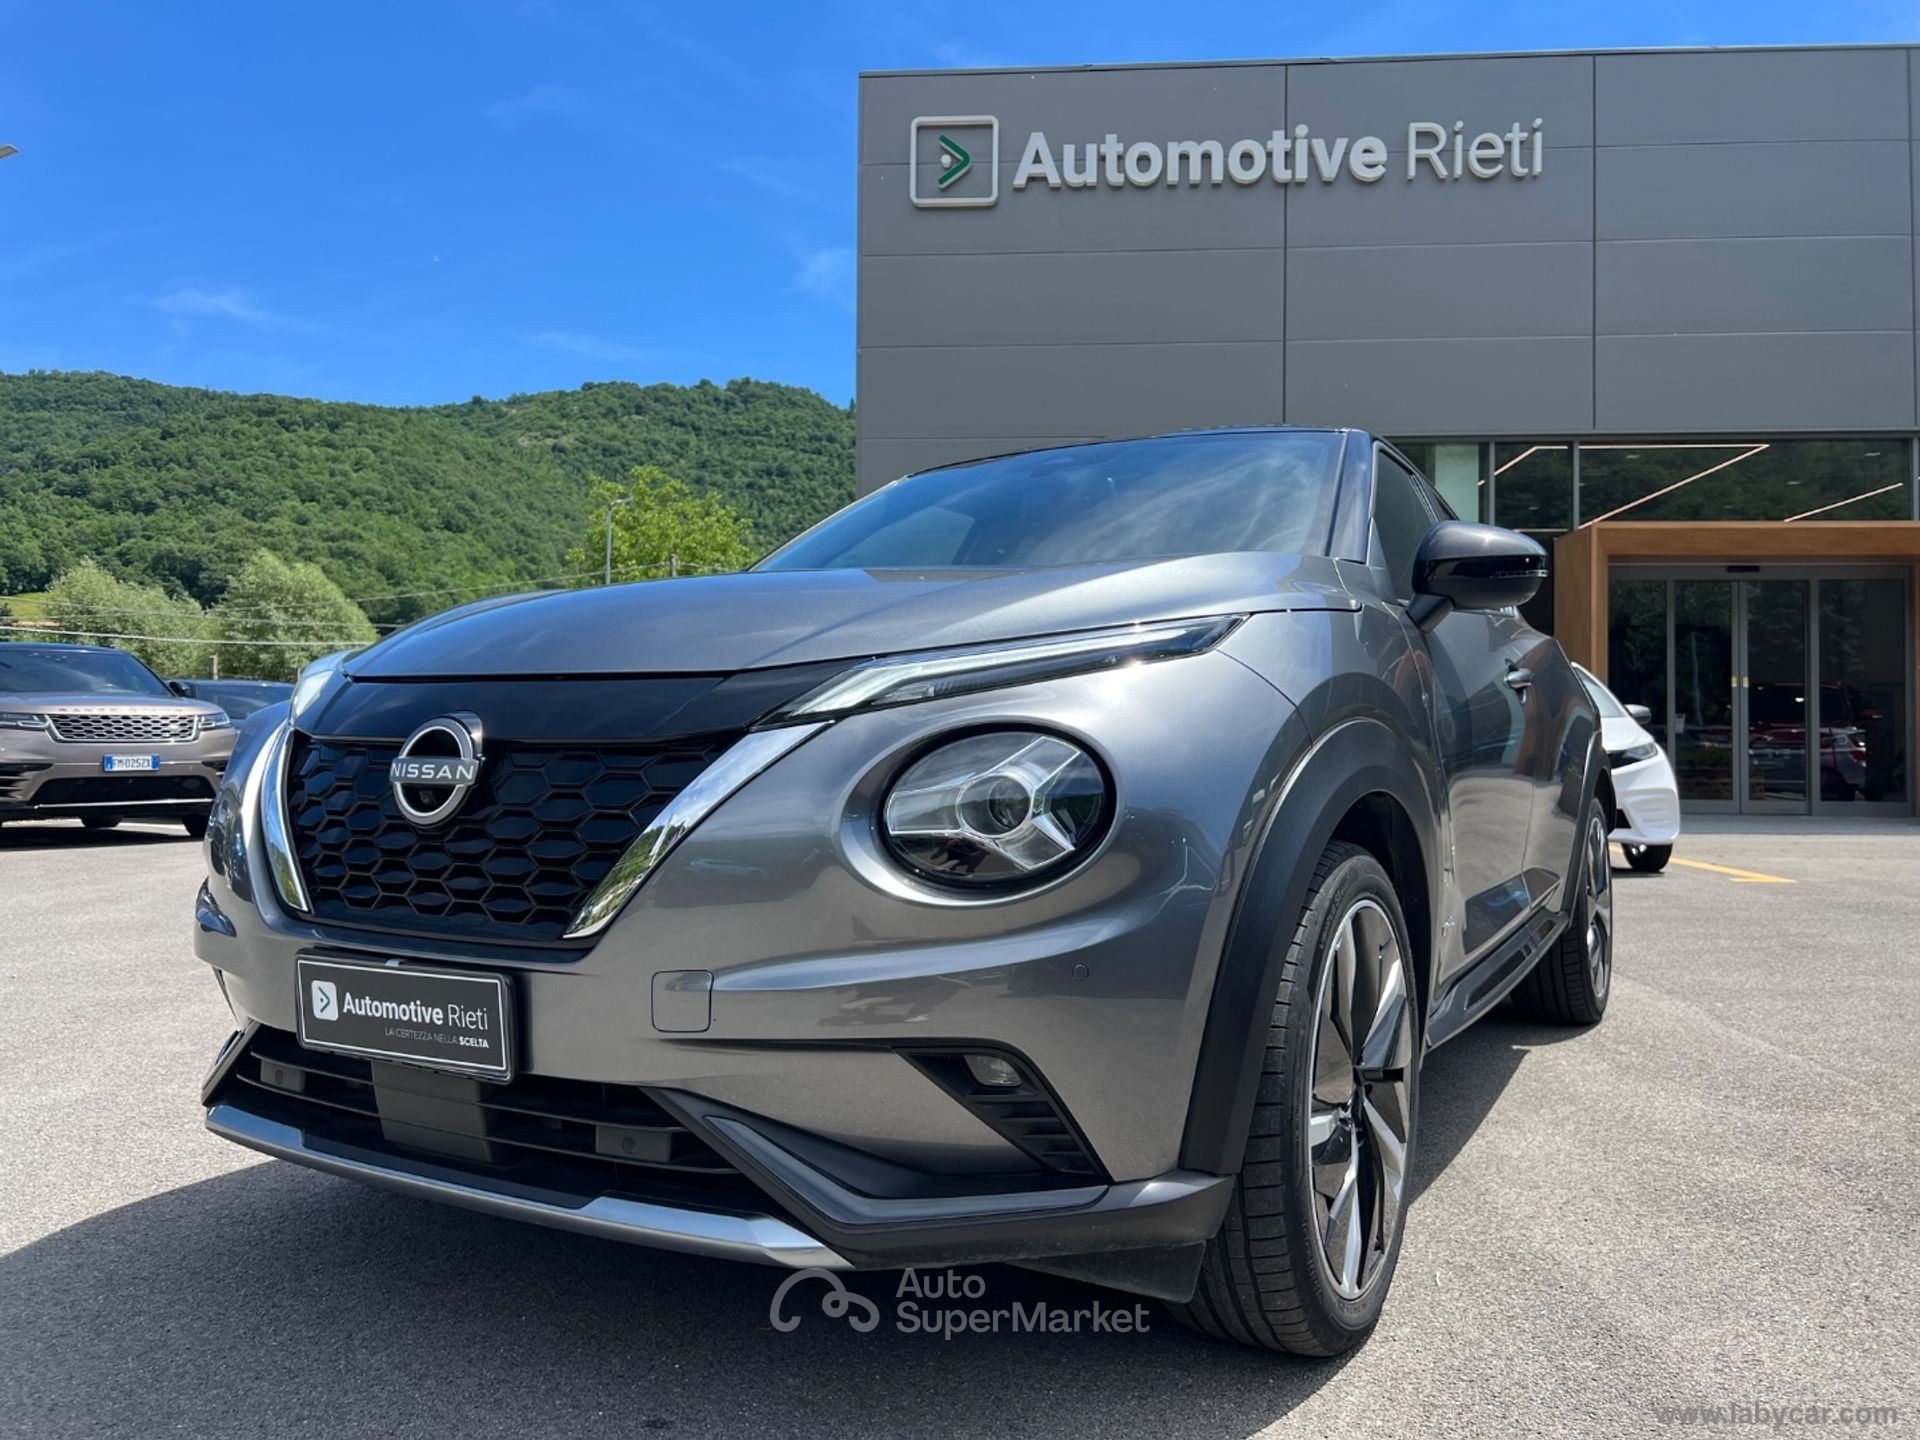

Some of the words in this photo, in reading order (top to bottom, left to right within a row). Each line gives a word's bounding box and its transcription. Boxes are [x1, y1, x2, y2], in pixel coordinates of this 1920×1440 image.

[1013, 124, 1388, 190] Automotive
[1406, 118, 1544, 182] Rieti
[390, 762, 475, 780] NISSAN
[343, 992, 444, 1026] Automotive
[447, 1003, 489, 1031] Rieti
[385, 1027, 395, 1037] LA
[396, 1028, 433, 1041] CERTEZZA
[434, 1033, 458, 1045] NELLA
[459, 1036, 490, 1049] SCELTA
